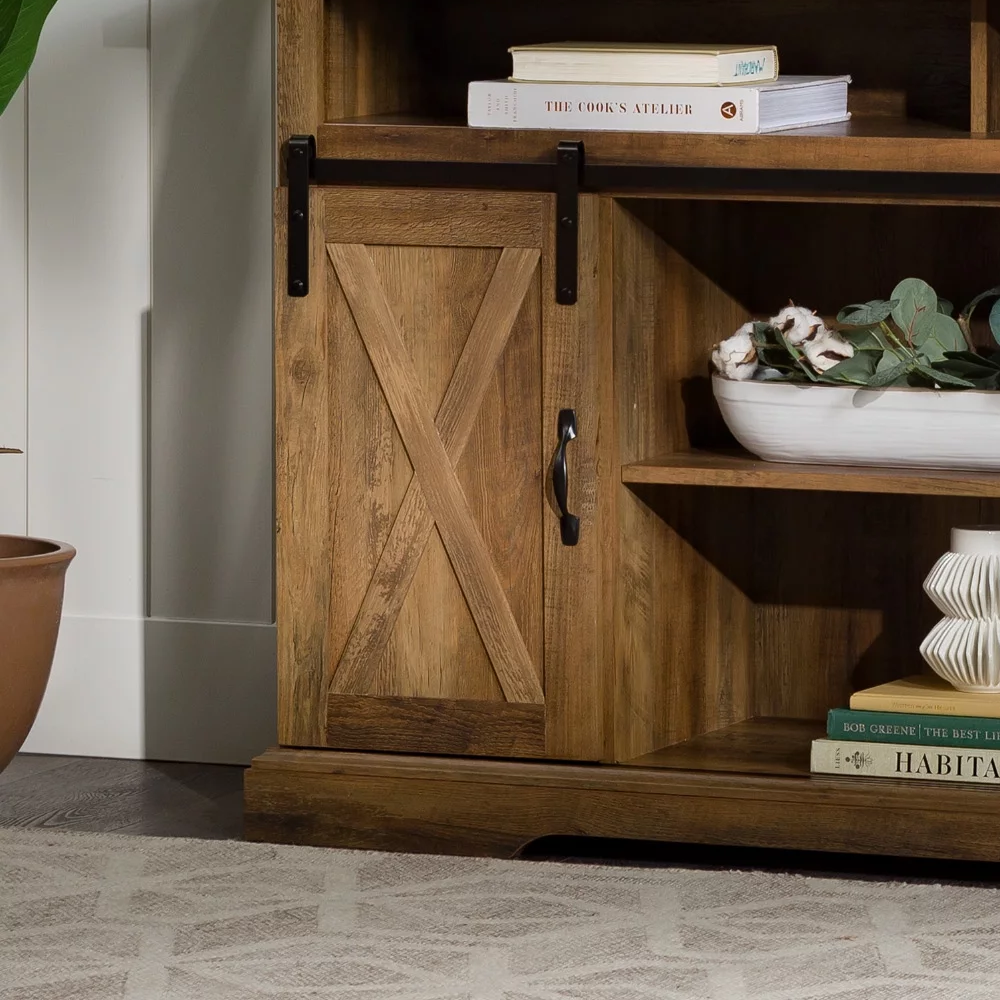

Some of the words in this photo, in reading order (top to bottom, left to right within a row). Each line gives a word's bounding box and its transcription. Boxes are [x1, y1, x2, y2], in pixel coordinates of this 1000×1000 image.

[544, 100, 573, 113] THE
[578, 101, 627, 114] COOK'S
[632, 103, 693, 115] ATELIER
[843, 722, 866, 733] BOB
[869, 724, 916, 736] GREENE
[923, 727, 949, 738] THE
[952, 728, 981, 740] BEST
